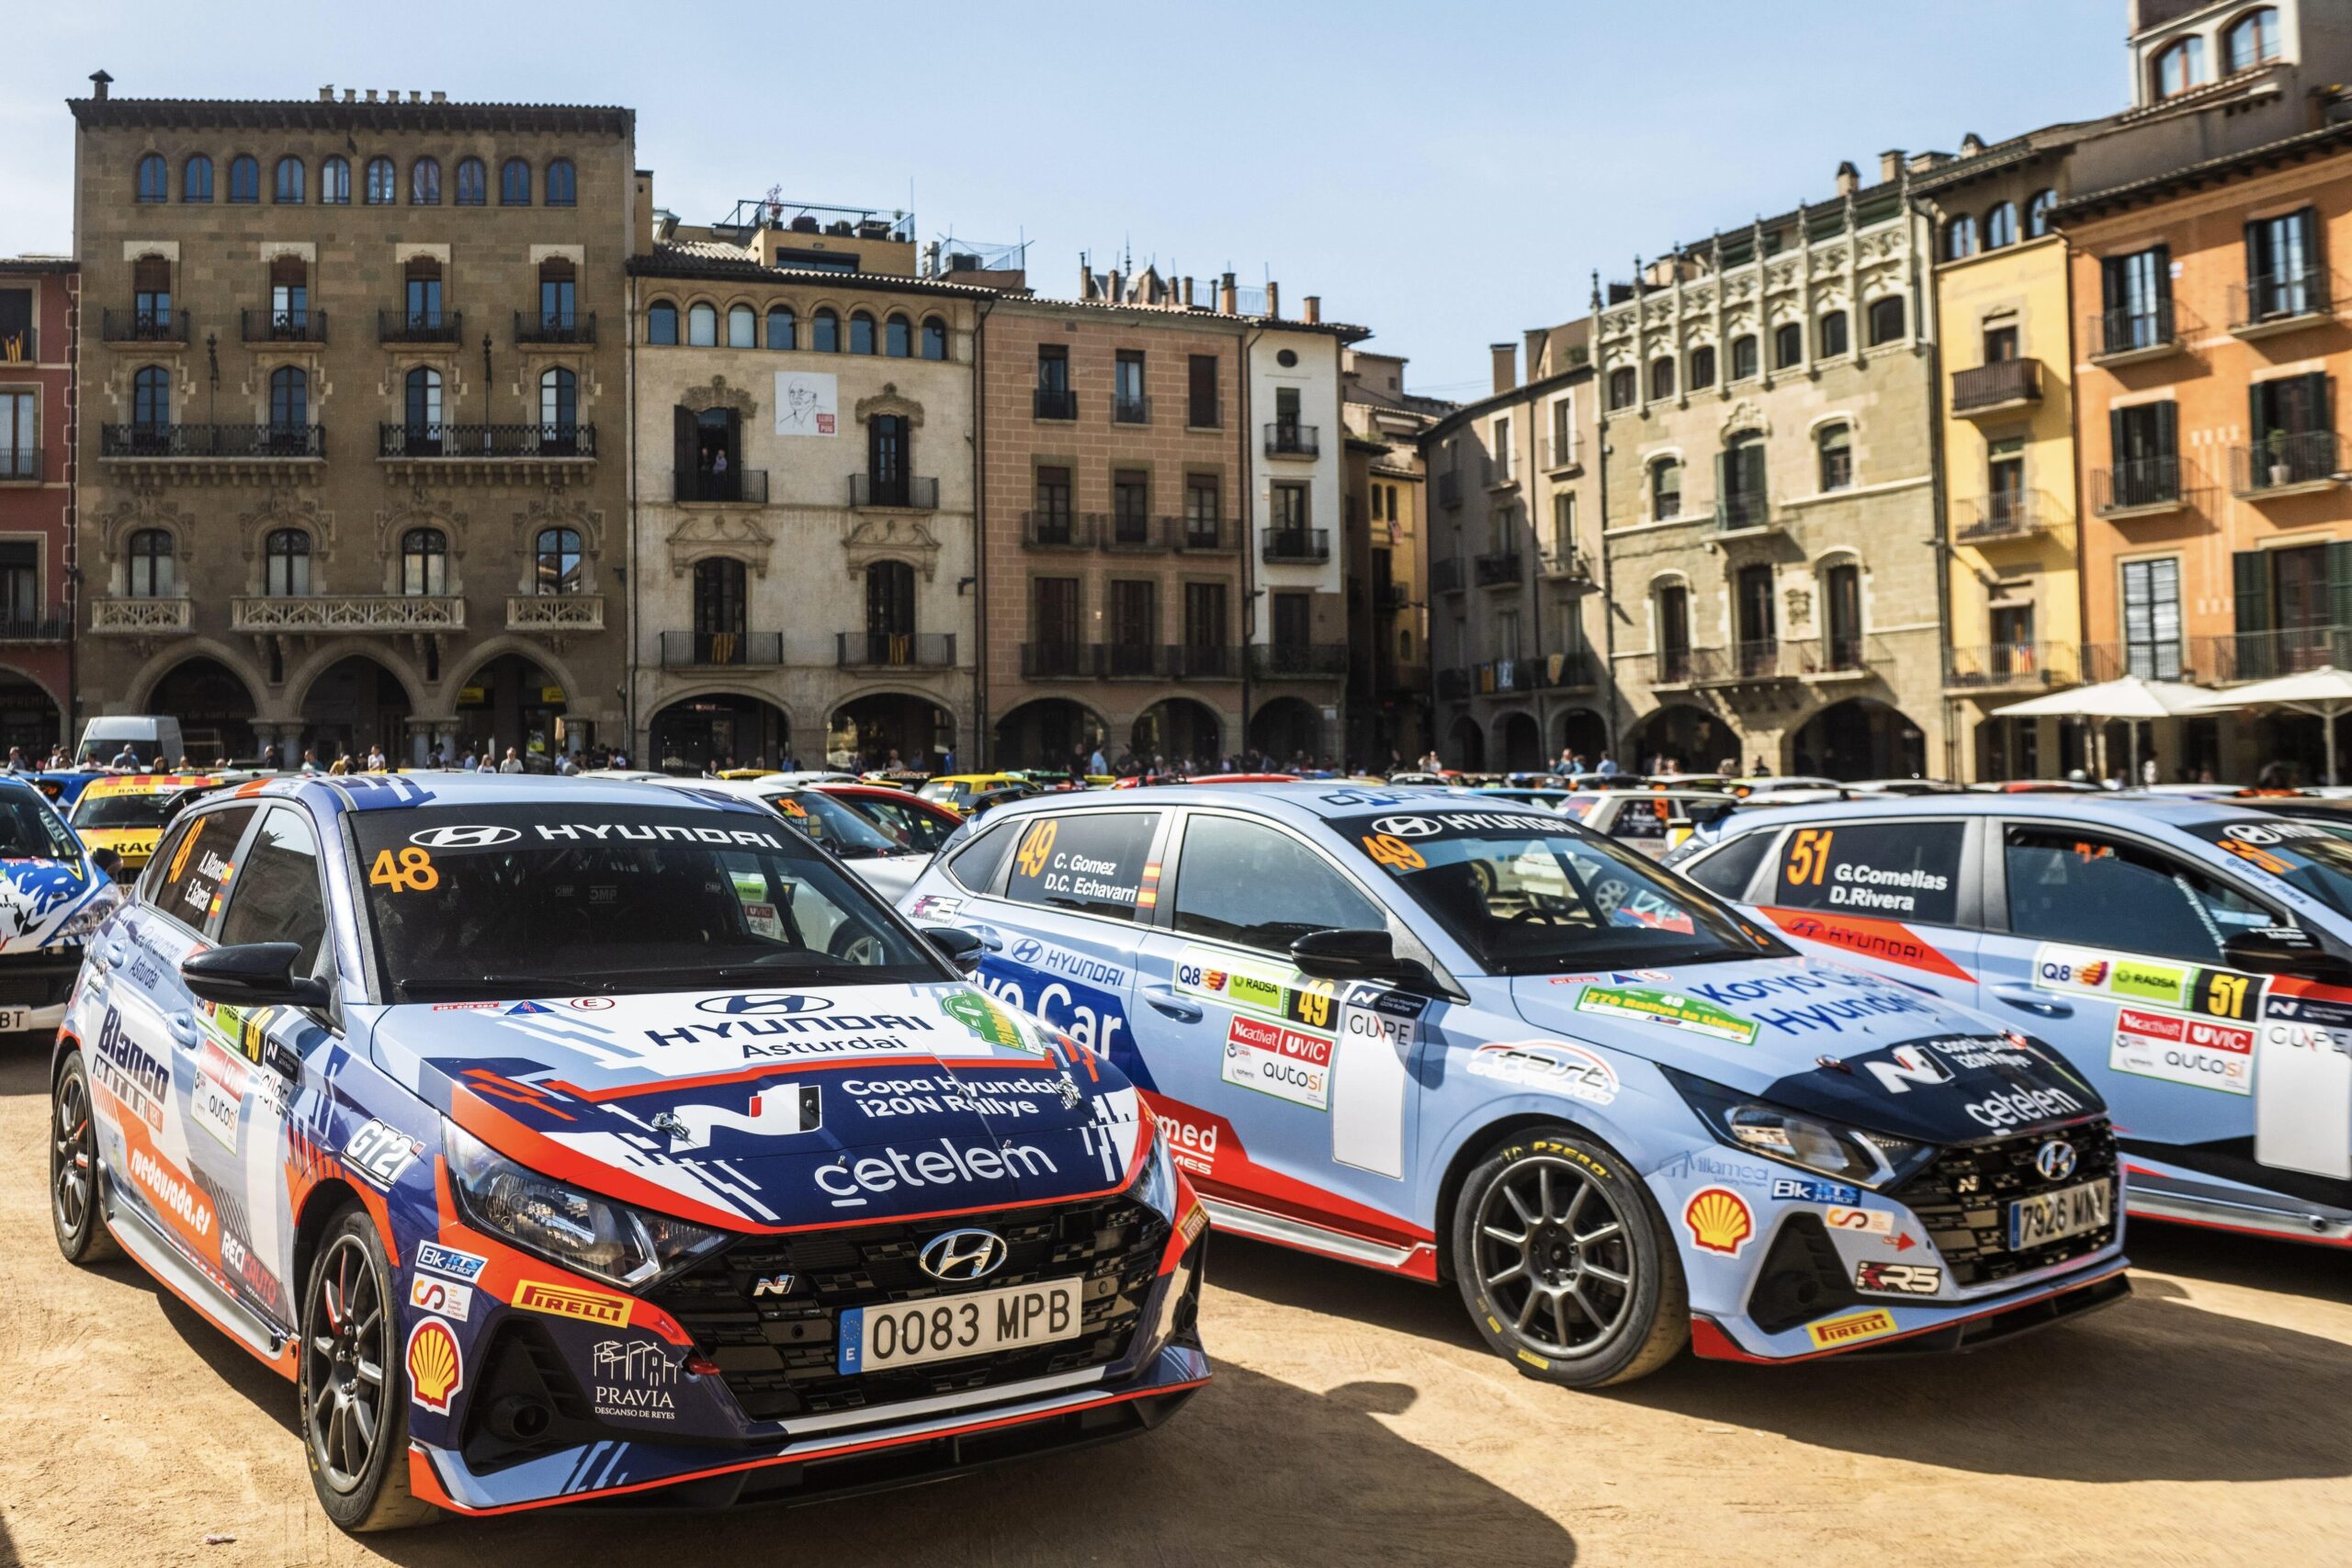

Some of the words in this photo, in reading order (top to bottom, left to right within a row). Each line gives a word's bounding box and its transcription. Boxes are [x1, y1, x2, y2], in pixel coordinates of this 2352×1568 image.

[535, 825, 783, 850] HYUNDAI
[1438, 814, 1582, 835] HYUNDAI
[112, 842, 157, 853] RAC
[1016, 819, 1057, 877] 49
[1363, 834, 1427, 871] 49
[1787, 829, 1834, 886] 51
[368, 846, 439, 894] 48
[1069, 854, 1116, 875] Gomez
[1834, 863, 1948, 891] G.Comellas
[1045, 873, 1069, 892] D.C.
[1073, 877, 1138, 903] Echavarri
[1829, 885, 1915, 911] D.Rivera
[1828, 928, 1924, 962] HYUNDAI
[1046, 950, 1125, 986] HYUNDAI
[1179, 965, 1201, 986] Q8
[2041, 962, 2071, 981] Q8
[1246, 978, 1278, 995] RADSA
[1687, 970, 1826, 1005] Koryo
[2133, 975, 2177, 989] RADSA
[1297, 979, 1335, 1027] 49
[2208, 974, 2249, 1019] 51
[643, 1014, 935, 1046] HYUNDAI
[1036, 983, 1123, 1060] Car
[742, 1034, 910, 1059] Asturdai
[1286, 1035, 1326, 1060] UVIC
[2192, 1026, 2247, 1050] UVIC
[98, 1003, 170, 1105] Blanco
[842, 1078, 934, 1096] Copa
[933, 1076, 1060, 1097] Hyundai
[855, 1096, 939, 1118] i20N
[941, 1095, 1040, 1118] Rallye
[814, 1138, 1057, 1207] cetelem
[2023, 1197, 2067, 1241] 7926
[420, 1247, 447, 1268] Bk
[443, 1264, 476, 1275] junior
[519, 1285, 625, 1322] PIRELLI
[872, 1302, 979, 1359] 0083
[997, 1289, 1070, 1340] MPB
[1815, 1313, 1888, 1342] PIRELLI
[845, 1347, 855, 1360] E
[595, 1386, 675, 1408] PRAVIA
[594, 1406, 638, 1417] DESCANSO
[651, 1411, 675, 1419] REYES
